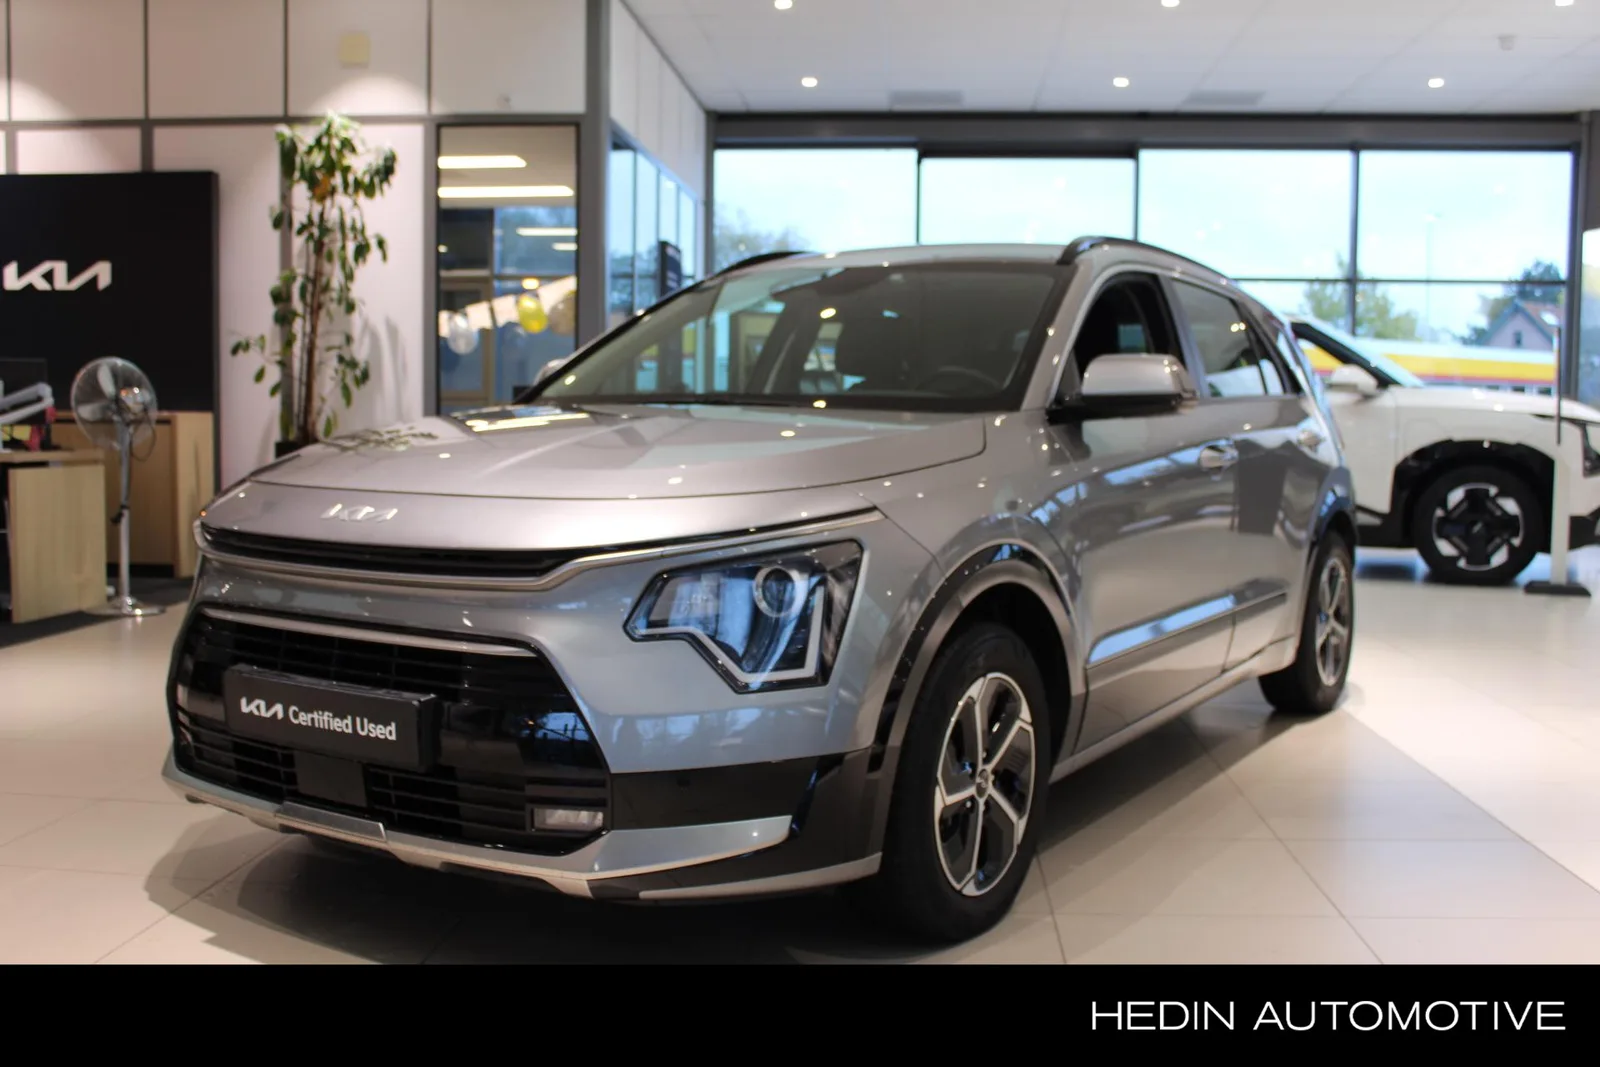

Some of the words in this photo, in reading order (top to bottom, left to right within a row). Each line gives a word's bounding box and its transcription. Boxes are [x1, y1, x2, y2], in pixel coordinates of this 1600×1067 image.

[3, 260, 112, 291] KIA
[320, 503, 398, 522] KIA
[240, 697, 284, 720] KIA
[288, 705, 353, 734] Certified
[355, 716, 397, 741] Used
